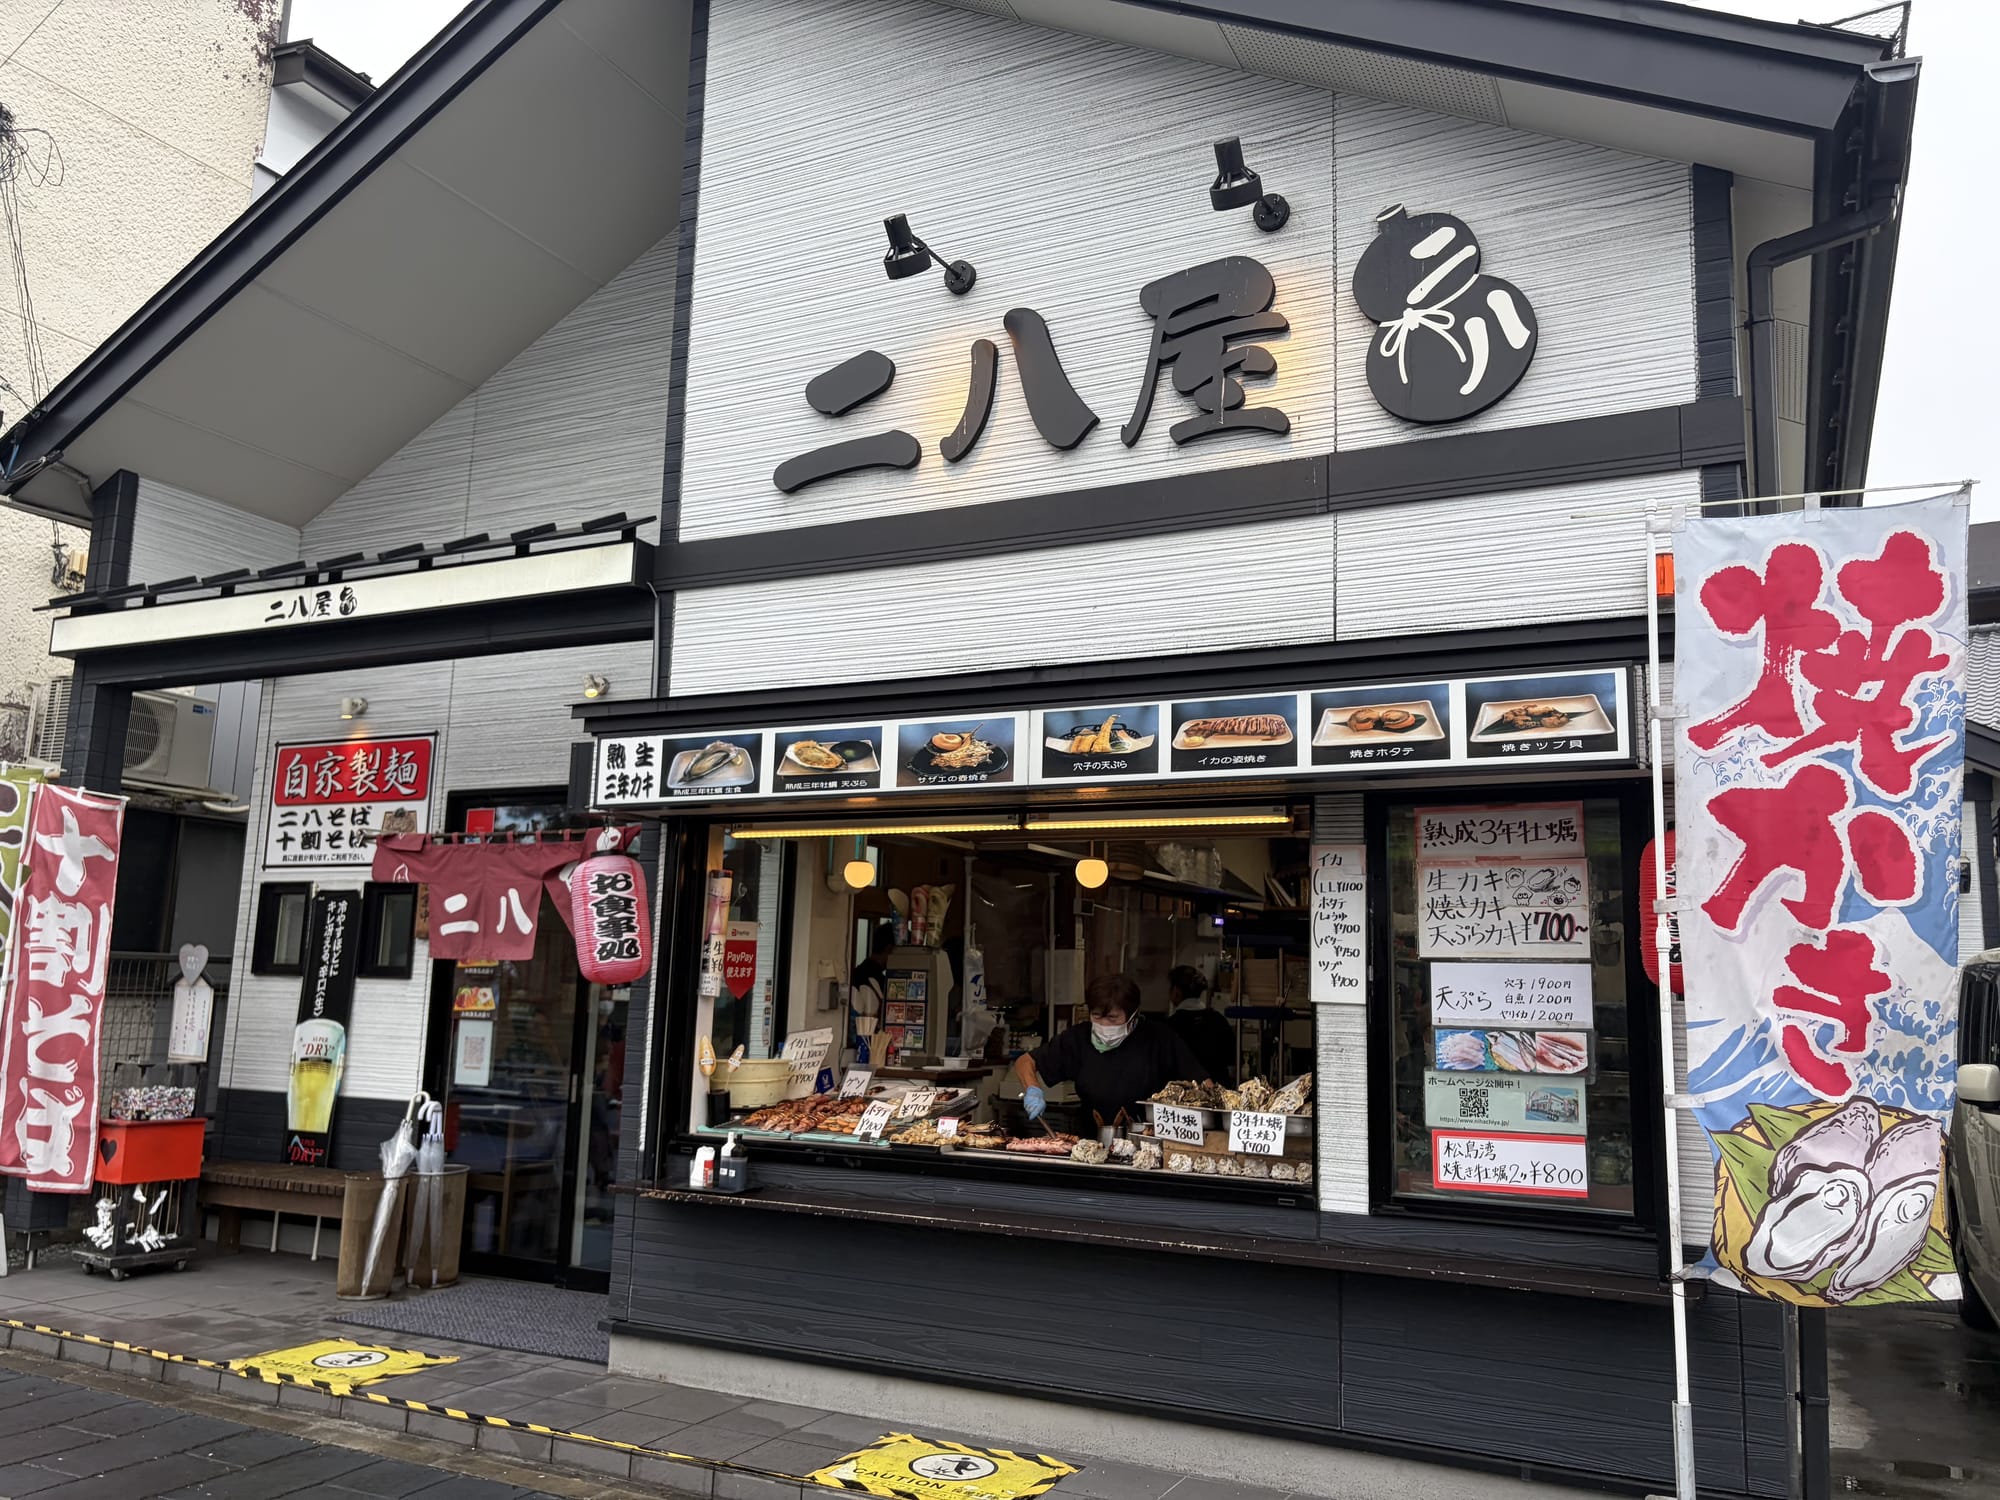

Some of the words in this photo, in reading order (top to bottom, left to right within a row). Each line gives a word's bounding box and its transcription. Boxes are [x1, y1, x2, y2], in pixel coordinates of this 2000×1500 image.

[773, 254, 1292, 493] 二八屋
[264, 590, 332, 622] 二八屋
[1350, 747, 1415, 758] 焼きホタテ
[1502, 739, 1583, 752] 焼きツブ貝
[1073, 760, 1128, 771] 穴子の天ぷら
[1198, 755, 1267, 765] イカの姿焼き
[284, 748, 417, 798] 自家製麺
[278, 806, 372, 827] 二八そば
[1687, 531, 1955, 1098] 焼かき
[1318, 853, 1342, 867] イカ
[1337, 881, 1363, 893] ¥1100
[1427, 869, 1503, 892] 生カキ
[440, 888, 534, 936] 二八
[1319, 897, 1347, 909] ホタテ
[1426, 894, 1507, 921] 焼きカキ
[589, 872, 640, 961] お食事処
[328, 900, 348, 977] 冷やすほどに
[1333, 923, 1361, 935] ¥700
[1428, 920, 1522, 948] 天ぷらカキ
[727, 951, 754, 964] PayPay
[1333, 945, 1361, 958] ¥750
[1318, 960, 1343, 972] ツブ
[1331, 973, 1359, 987] ¥700
[1504, 978, 1526, 990] 穴子
[16, 806, 115, 1176] 十割そば
[1436, 986, 1492, 1011] 天ぷら
[1173, 1126, 1200, 1141] ¥800
[1241, 1140, 1271, 1153] ¥700
[1443, 1140, 1497, 1161] 松島湾
[1529, 1160, 1584, 1185] ¥800
[853, 1467, 947, 1490] CAUTION
